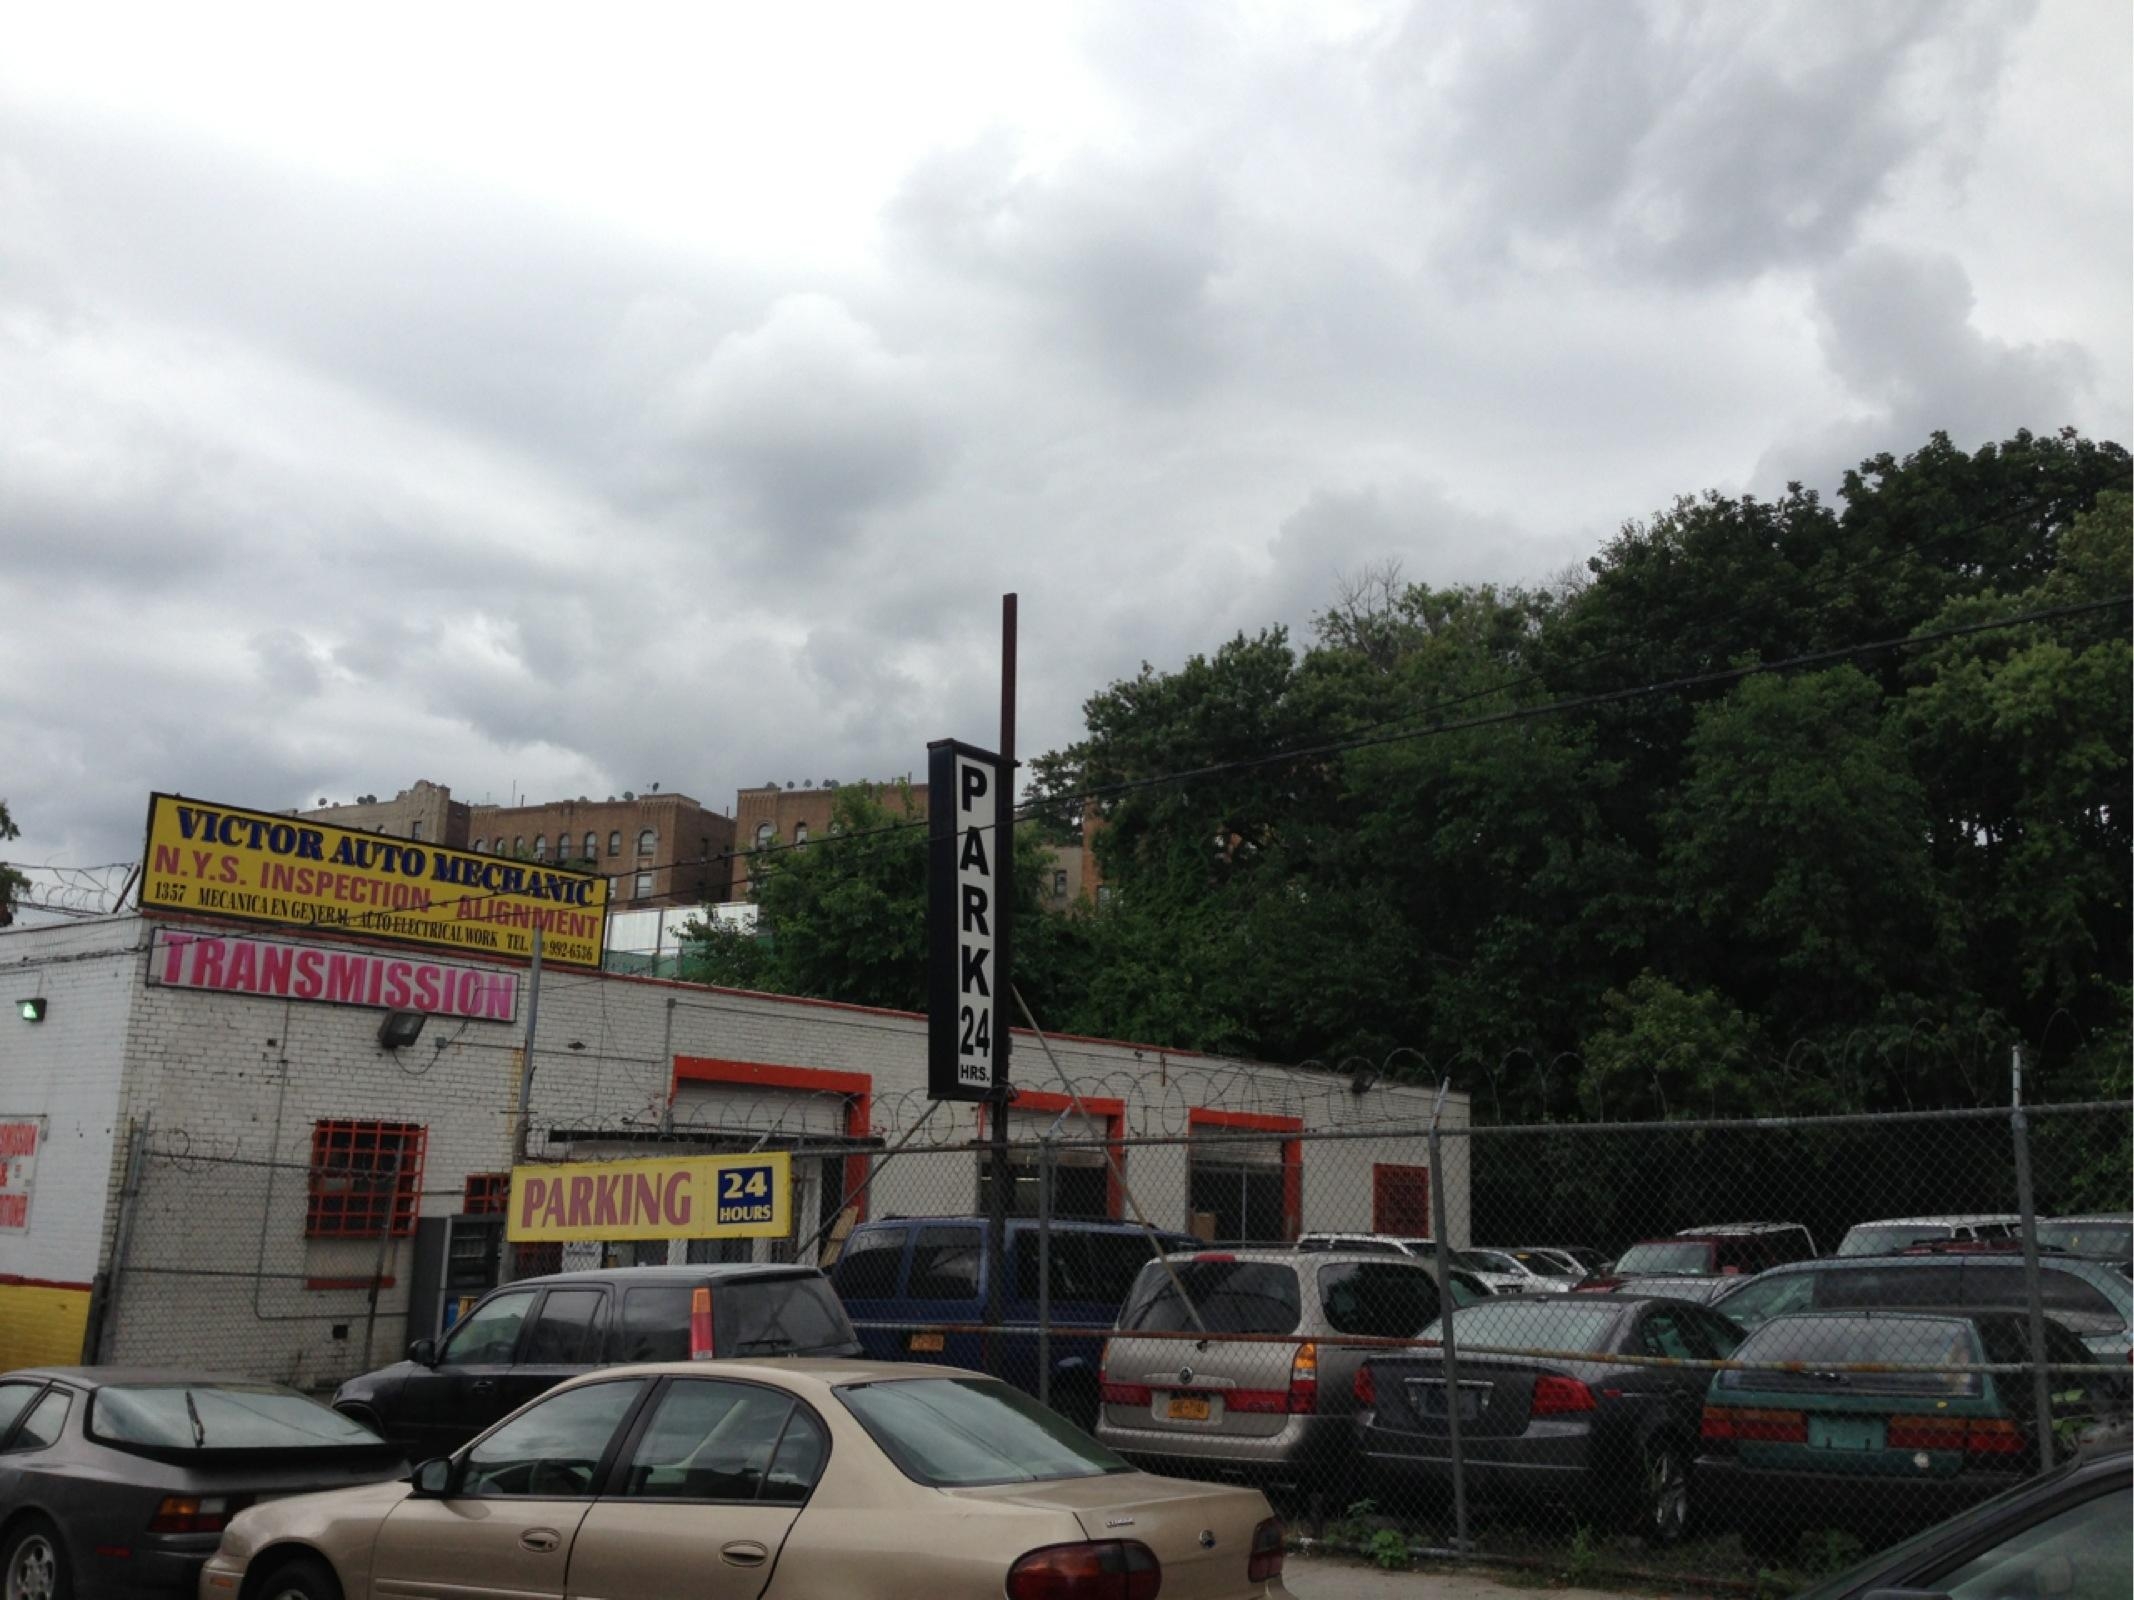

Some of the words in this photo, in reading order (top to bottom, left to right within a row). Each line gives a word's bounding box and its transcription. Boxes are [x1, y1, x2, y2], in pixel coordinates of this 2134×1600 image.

[177, 806, 324, 861] VICTOR
[329, 836, 426, 878] AUTO
[430, 852, 594, 907] MECHANIC
[958, 764, 991, 998] PARK
[154, 844, 247, 886] N.Y.S.
[260, 861, 431, 913] INSPECTION
[456, 895, 599, 939] ALIGNMENT
[154, 881, 187, 902] 1357
[198, 887, 268, 919] MECANICA
[271, 897, 289, 918] EN
[392, 916, 463, 942] ELECTRICAL
[465, 927, 498, 946] WORK
[161, 932, 513, 1019] TRANSMISSION
[959, 1005, 991, 1059] 24
[959, 1065, 990, 1082] HRS.
[521, 1171, 692, 1228] PARKING
[723, 1170, 768, 1199] 24
[718, 1204, 772, 1222] HOURS
